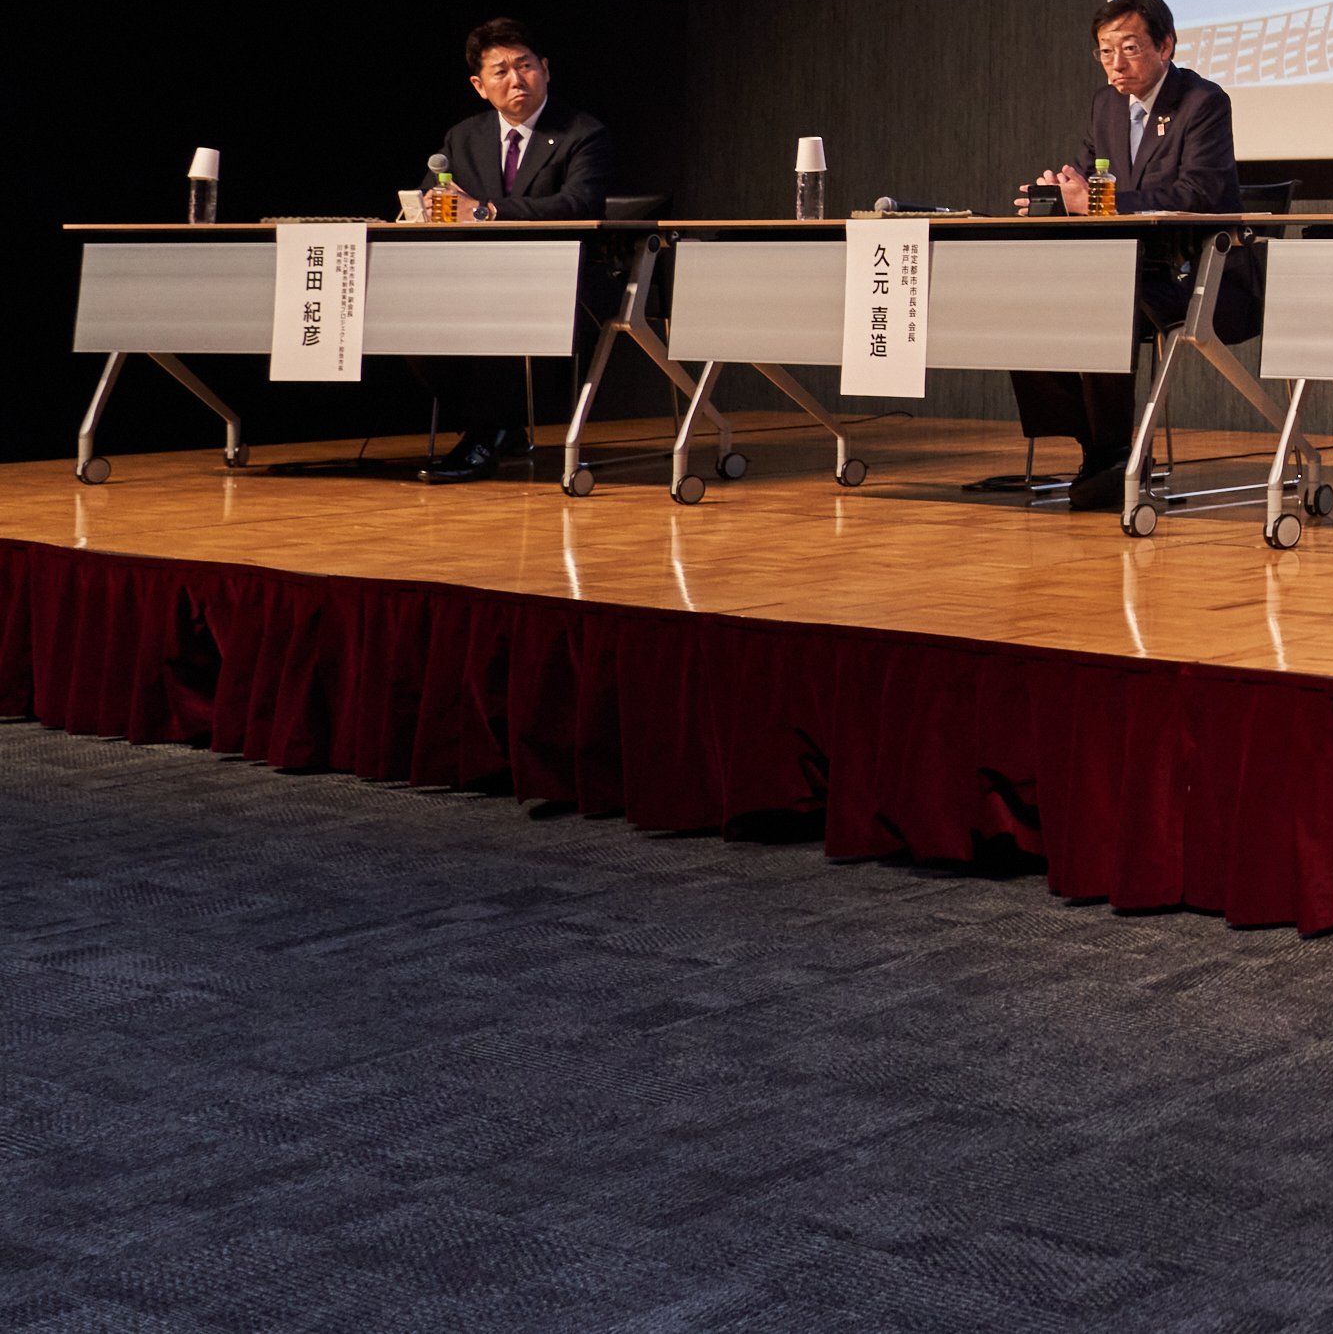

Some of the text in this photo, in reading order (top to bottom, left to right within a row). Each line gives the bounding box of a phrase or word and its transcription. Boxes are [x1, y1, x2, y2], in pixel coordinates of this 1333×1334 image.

[302, 246, 325, 346] 福田 紀彦
[870, 244, 890, 357] 久元 喜造
[901, 244, 909, 285] 神戸市長
[908, 244, 918, 342] 指定都市市長会 会長
